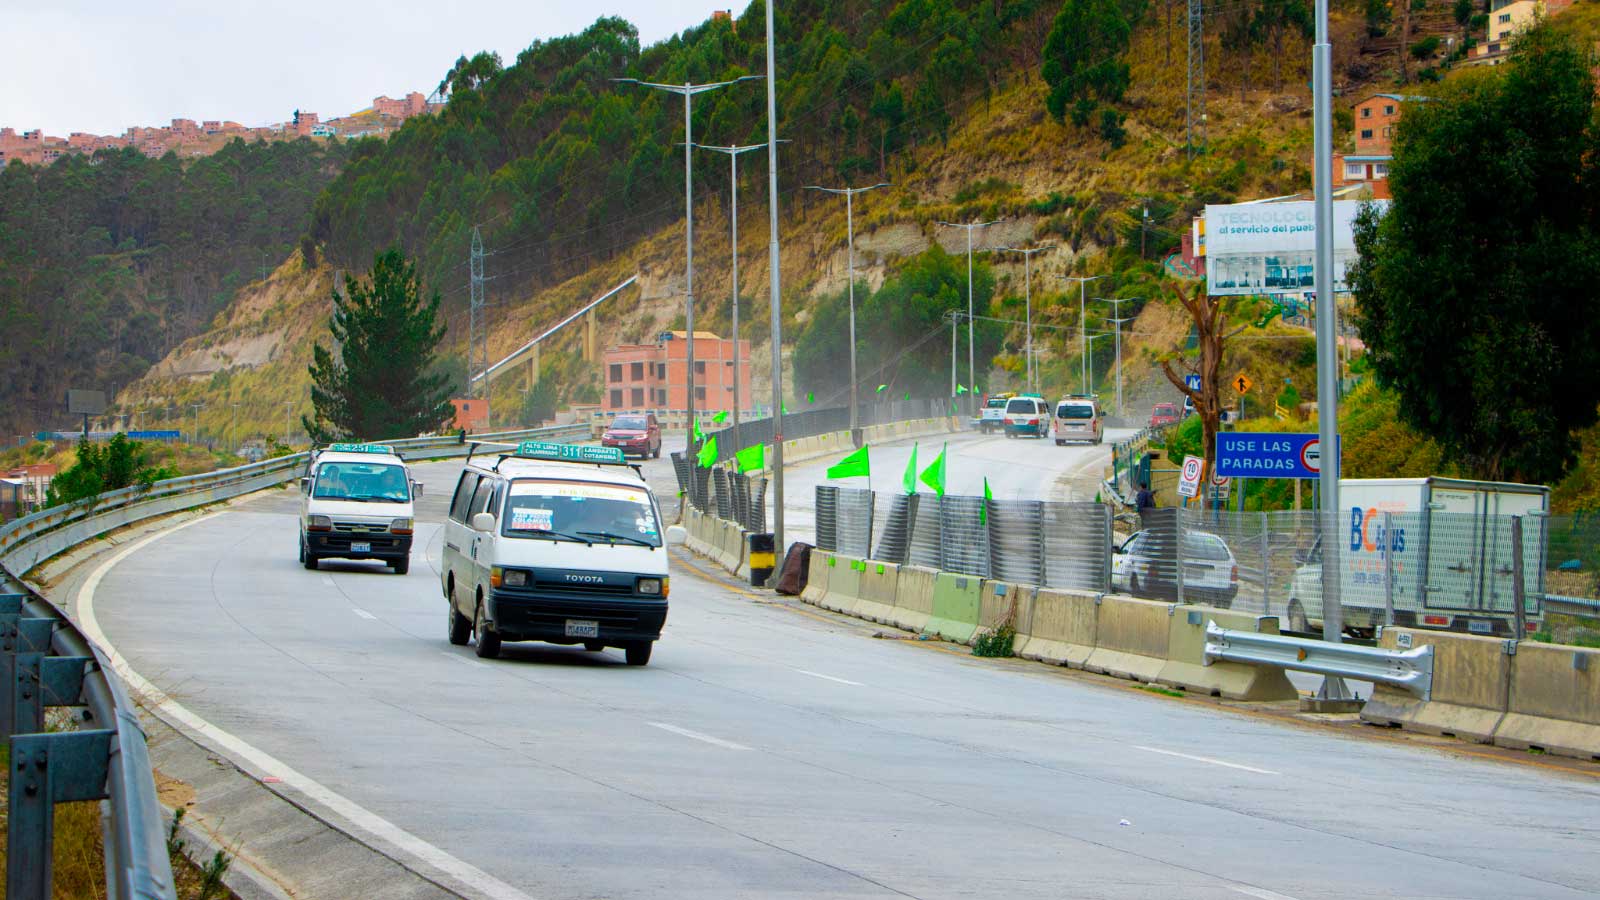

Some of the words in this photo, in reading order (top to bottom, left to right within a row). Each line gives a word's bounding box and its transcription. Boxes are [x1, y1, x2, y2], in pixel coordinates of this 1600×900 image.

[1219, 211, 1313, 224] TECNOLOGI
[1219, 225, 1228, 234] al
[1230, 224, 1270, 234] servicio
[1272, 224, 1287, 233] del
[562, 446, 581, 457] 311
[1225, 441, 1256, 452] USE
[1263, 441, 1292, 452] LAS
[1222, 458, 1295, 470] PARADAS
[565, 574, 604, 583] TOYOTA
